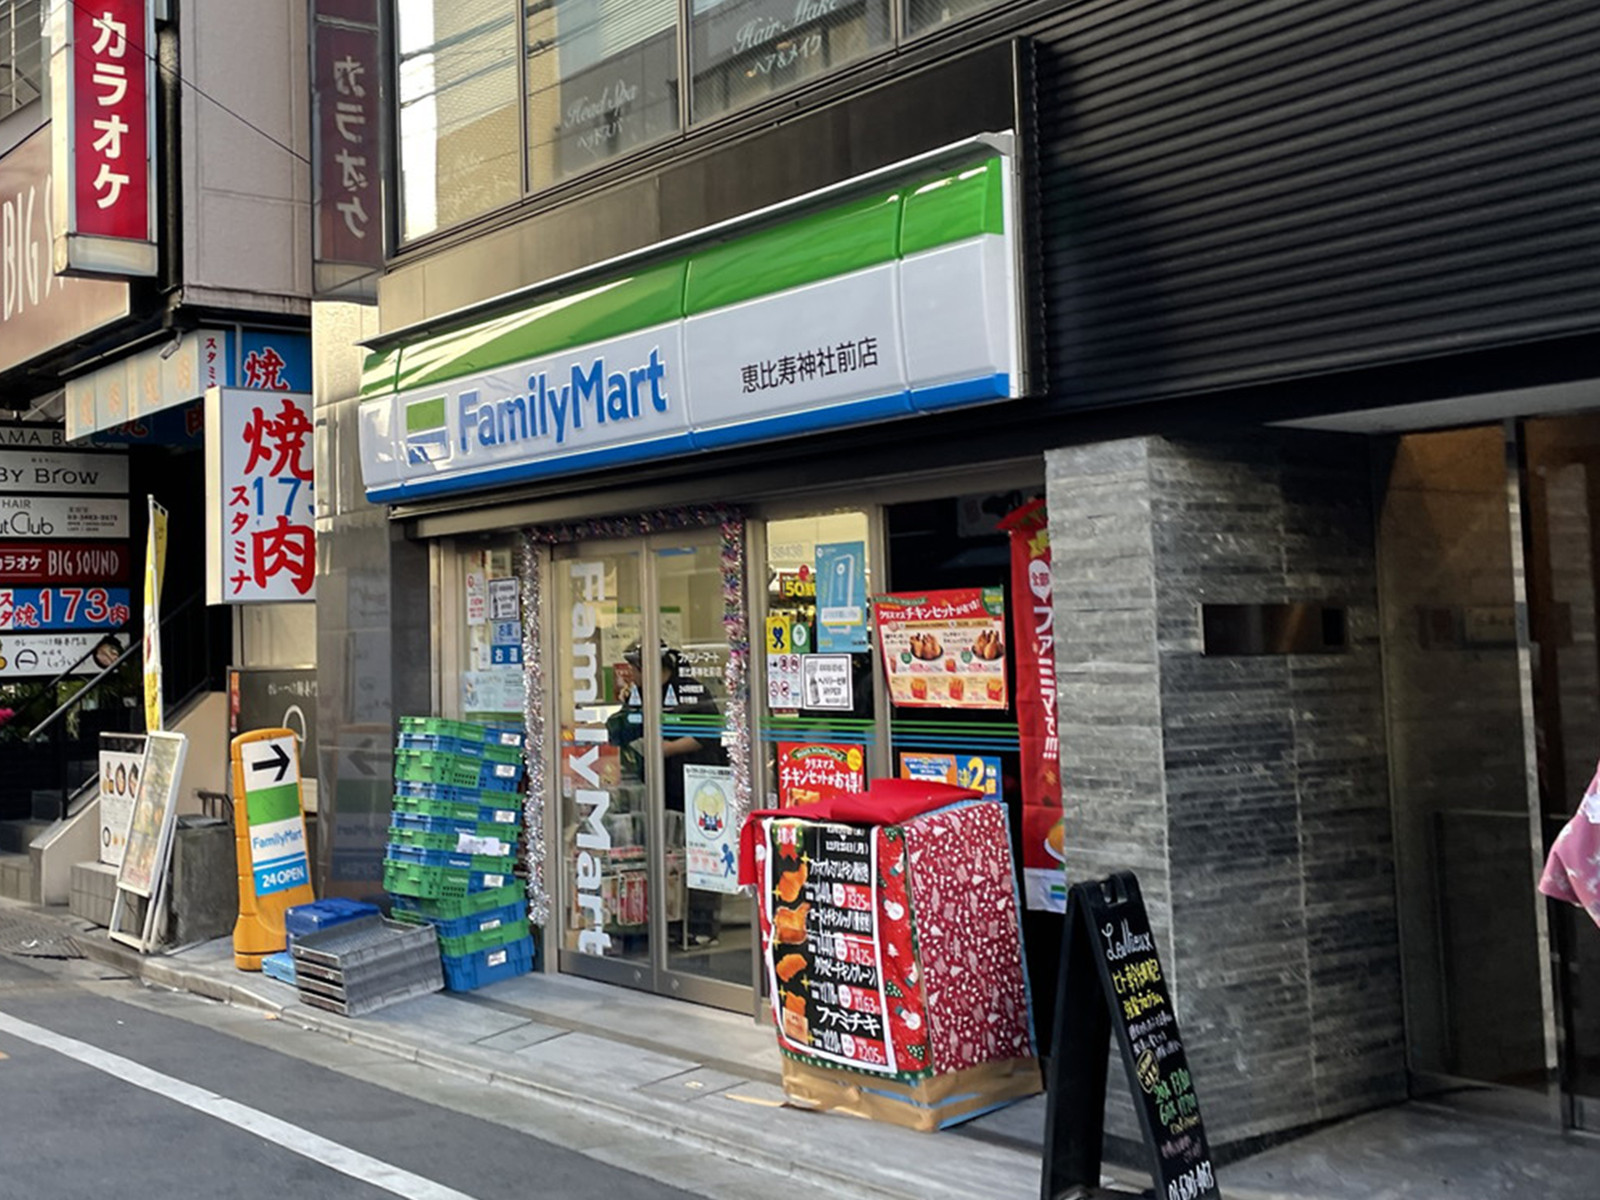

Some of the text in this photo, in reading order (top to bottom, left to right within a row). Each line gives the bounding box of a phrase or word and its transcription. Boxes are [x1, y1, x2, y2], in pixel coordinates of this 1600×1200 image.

[92, 12, 130, 209] カラオケ
[3, 185, 38, 321] BIG
[458, 345, 669, 453] FamilyMart
[740, 336, 878, 394] 恵比寿神社前店
[2, 499, 32, 509] HAIR
[48, 550, 73, 576] BIG
[76, 550, 119, 576] SOUND
[229, 486, 252, 594] スタミナ
[251, 515, 315, 594] 肉
[253, 828, 303, 850] FamilyMart
[816, 1005, 881, 1037] ファミチキ
